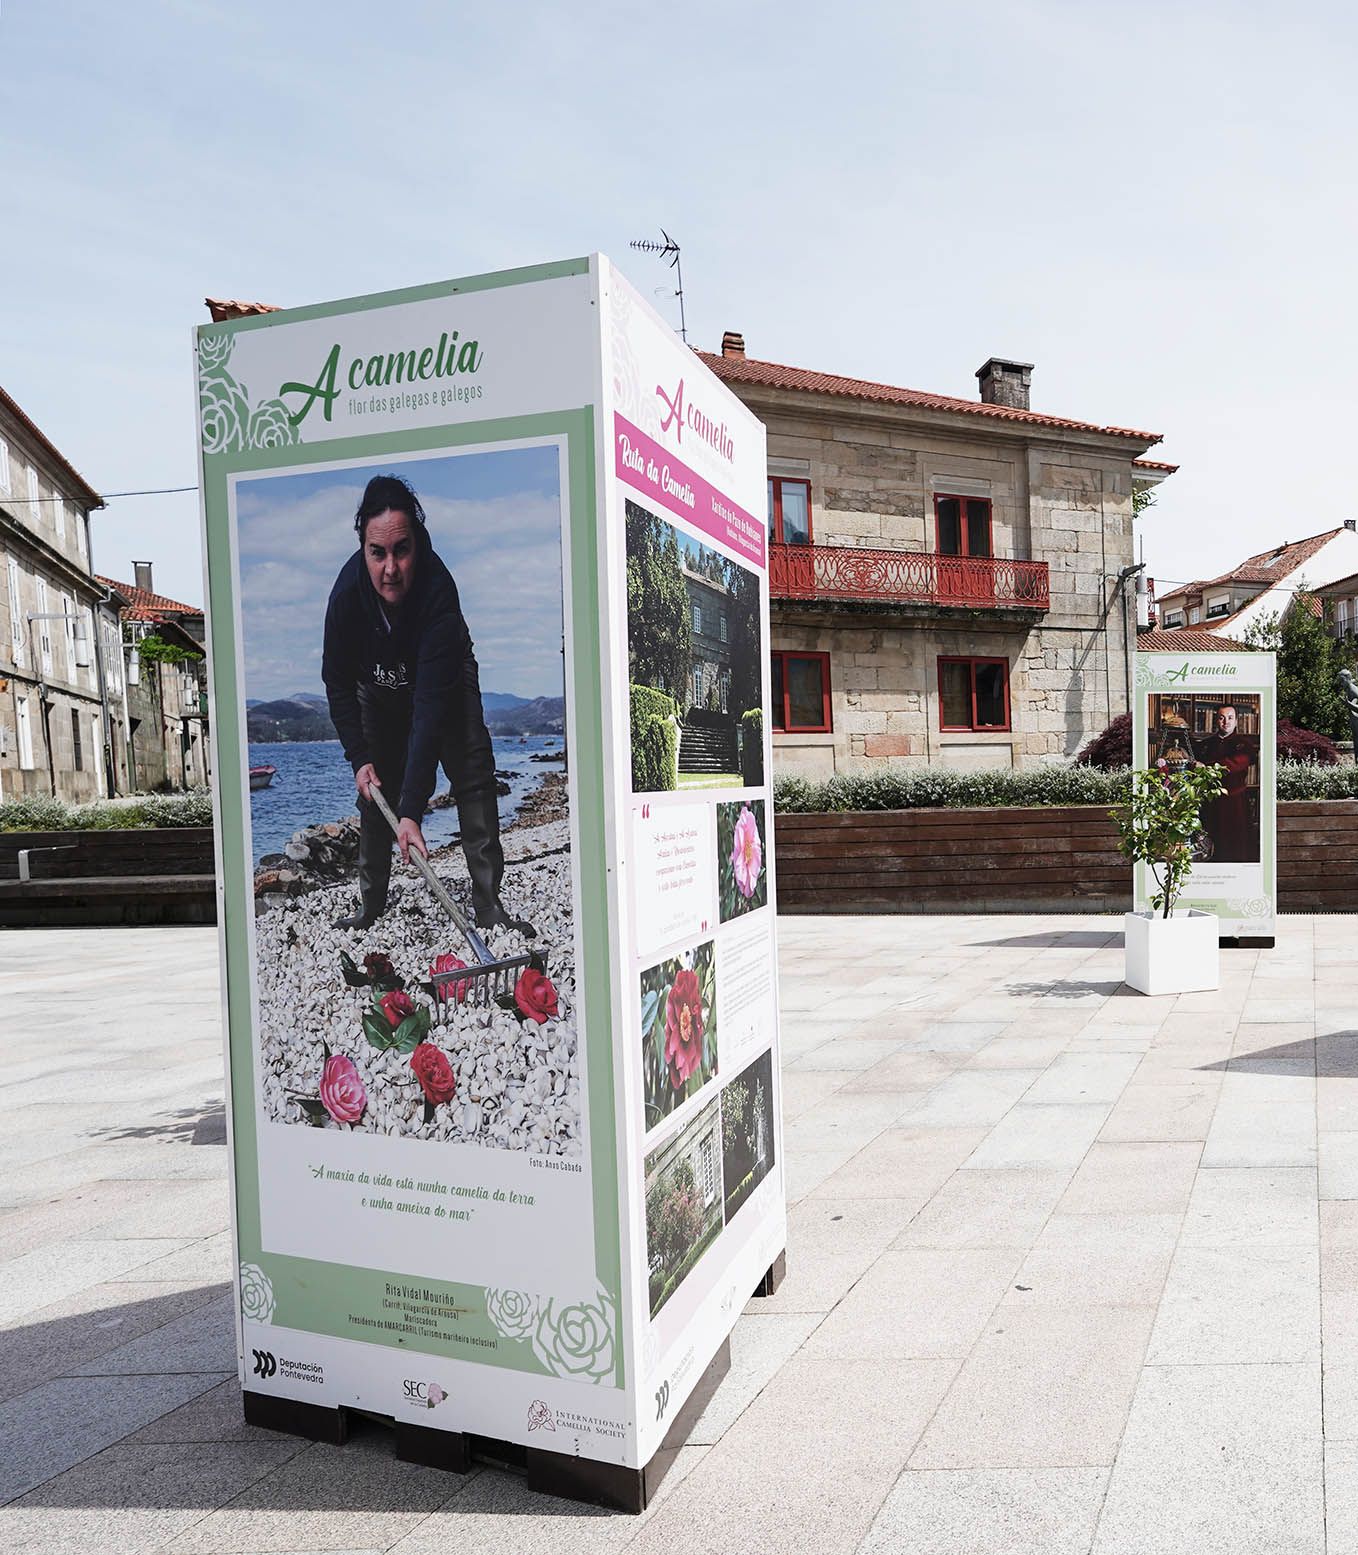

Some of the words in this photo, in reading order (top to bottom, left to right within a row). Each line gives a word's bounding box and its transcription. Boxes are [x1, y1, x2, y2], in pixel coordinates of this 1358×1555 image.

[279, 344, 341, 426] A
[348, 331, 484, 390] camelia
[349, 398, 367, 416] flor
[369, 396, 386, 412] das
[390, 392, 430, 414] galegas
[432, 391, 438, 404] e
[440, 385, 482, 406] galegos
[656, 378, 685, 444] A
[688, 402, 734, 464] camelia
[618, 434, 645, 475] Ruta
[646, 458, 659, 484] da
[661, 465, 696, 509] Camelia
[1166, 662, 1189, 682] A
[1192, 664, 1238, 675] camelia
[529, 1158, 544, 1168] Foto:
[560, 1161, 582, 1172] Cabada
[326, 1170, 355, 1182] maxia
[358, 1172, 370, 1184] da
[372, 1174, 393, 1186] vida
[396, 1178, 414, 1190] está
[416, 1180, 448, 1194] nunha
[450, 1186, 490, 1200] camelia
[492, 1189, 506, 1202] da
[510, 1190, 536, 1206] terra
[362, 1198, 367, 1207] e
[370, 1198, 394, 1211] unha
[396, 1202, 430, 1216] ameixa
[434, 1204, 446, 1218] do
[386, 1282, 401, 1296] Rita
[402, 1285, 422, 1300] Vidal
[424, 1290, 454, 1306] Mouriño
[404, 1314, 438, 1327] Mariscadora
[430, 1306, 438, 1316] de
[438, 1308, 458, 1320] Arousa)
[377, 1319, 384, 1329] de
[418, 1328, 442, 1340] (Turismo
[442, 1331, 470, 1344] mariñeiro
[470, 1337, 498, 1350] inclusivo)
[280, 1358, 323, 1374] Deputación
[280, 1368, 324, 1384] Pontevedra
[403, 1380, 426, 1400] SEC
[556, 1410, 625, 1430] INTERNATIONAL
[556, 1420, 592, 1433] CAMELLIA
[596, 1427, 626, 1438] SOCIETY
